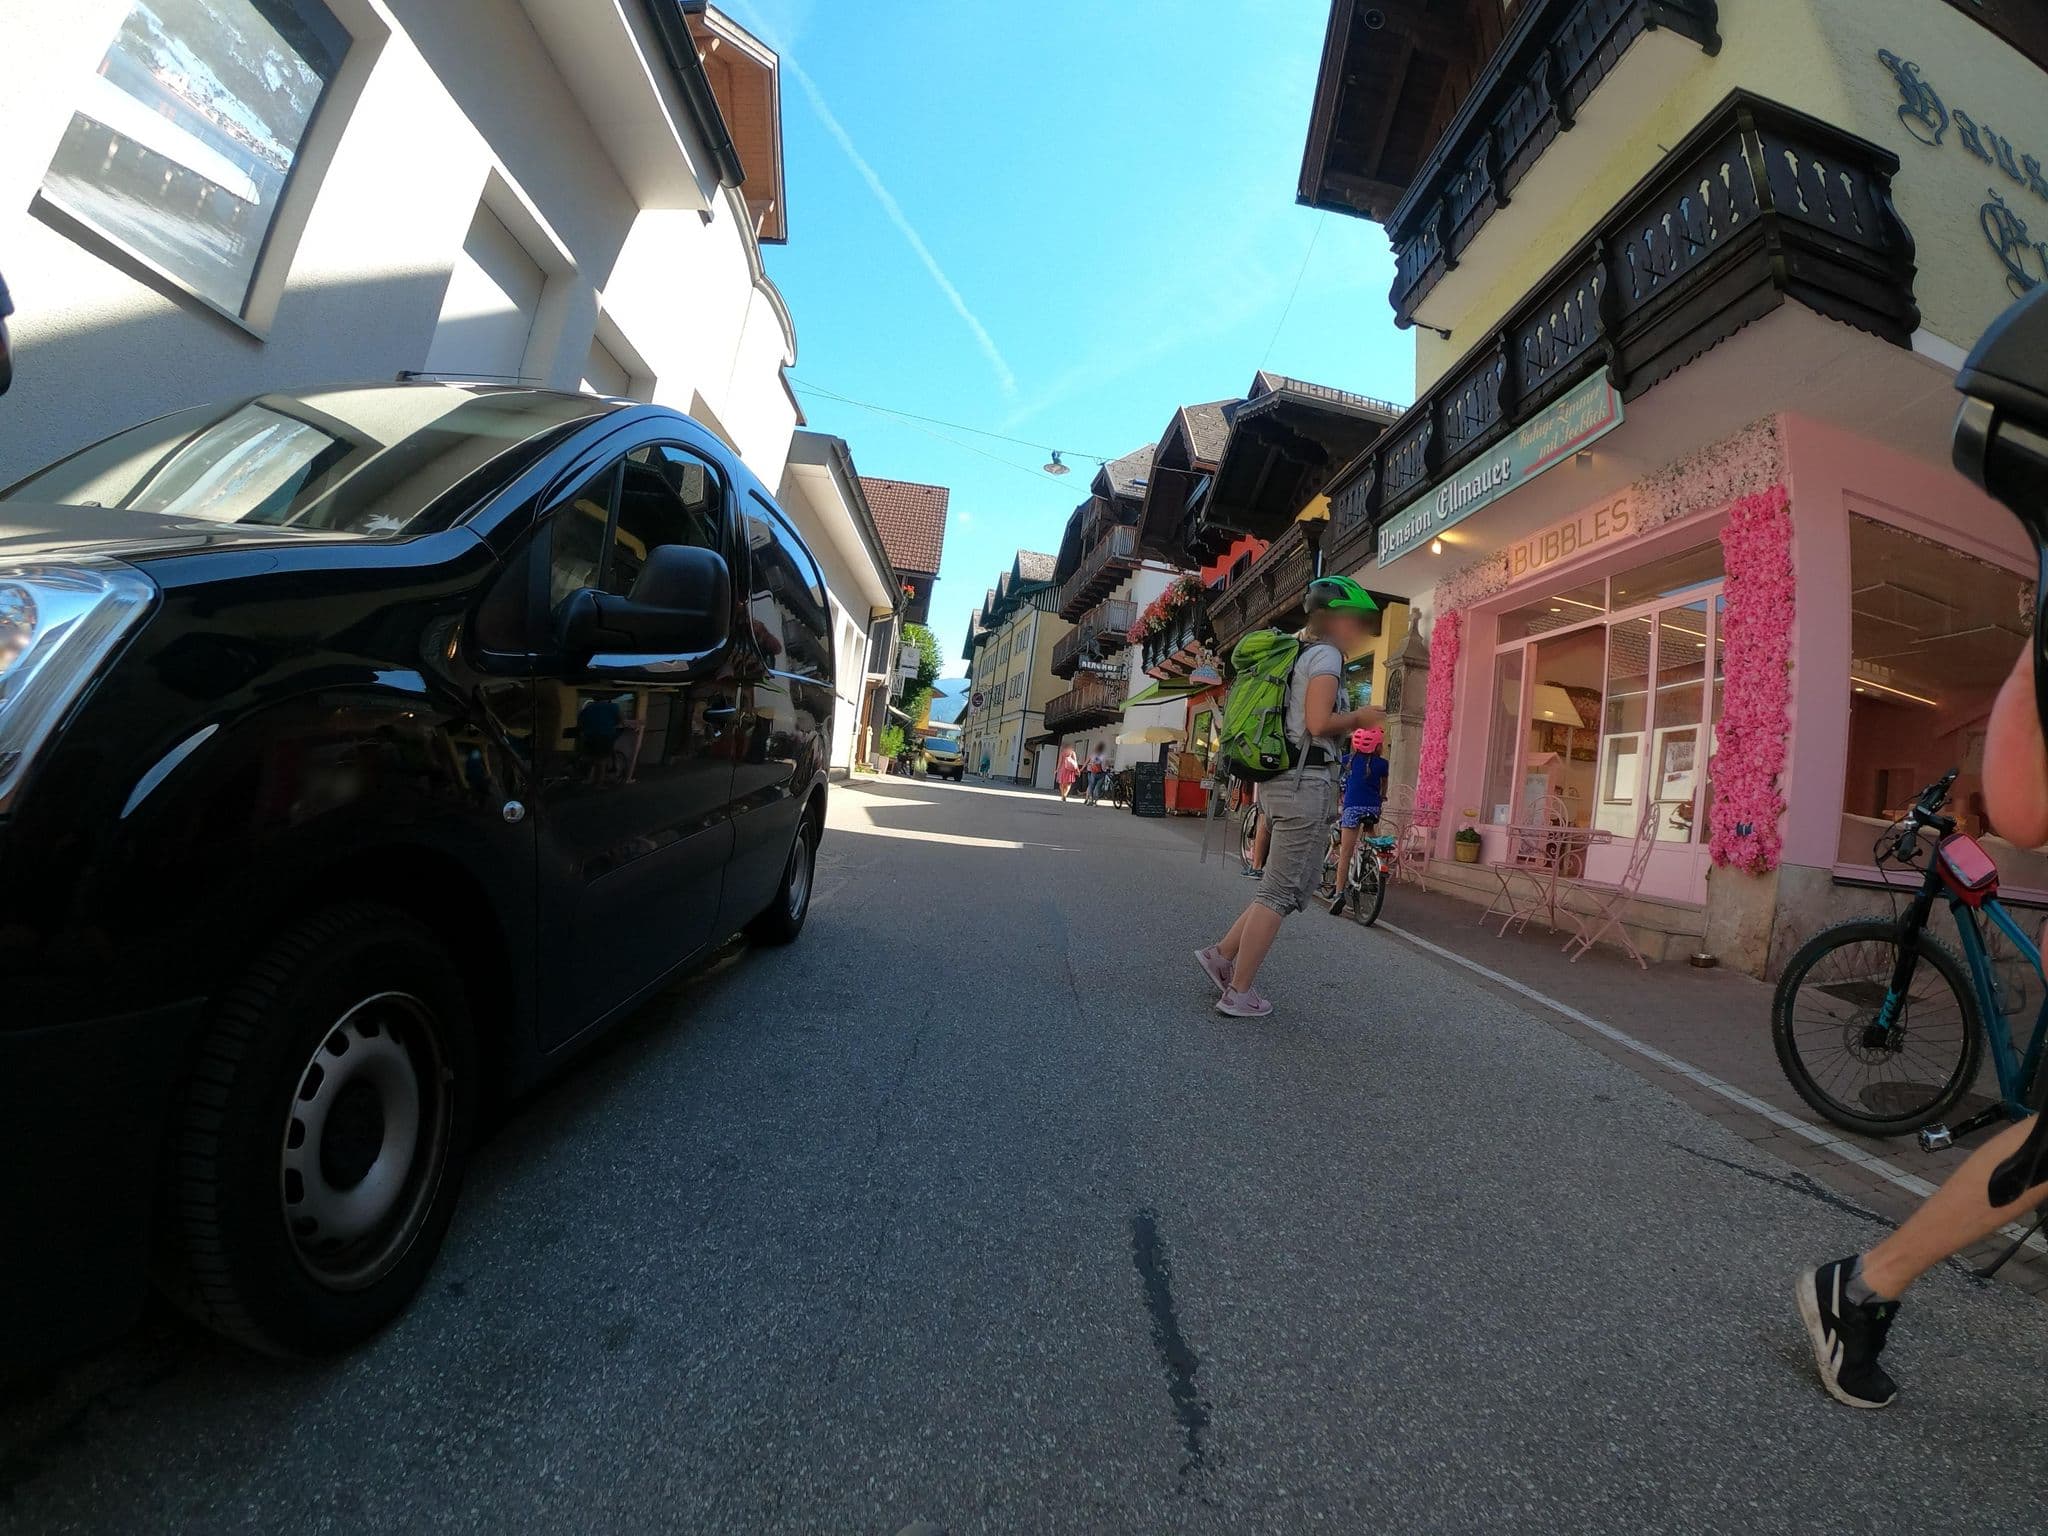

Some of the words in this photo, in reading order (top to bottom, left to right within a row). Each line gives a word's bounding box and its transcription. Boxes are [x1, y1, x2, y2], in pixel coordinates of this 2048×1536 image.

[1556, 386, 1602, 423] Zimmer
[1538, 434, 1559, 459] mit
[1379, 509, 1432, 562] Pension
[1436, 457, 1512, 520] Ellmauer
[1513, 498, 1629, 577] BUBBLES
